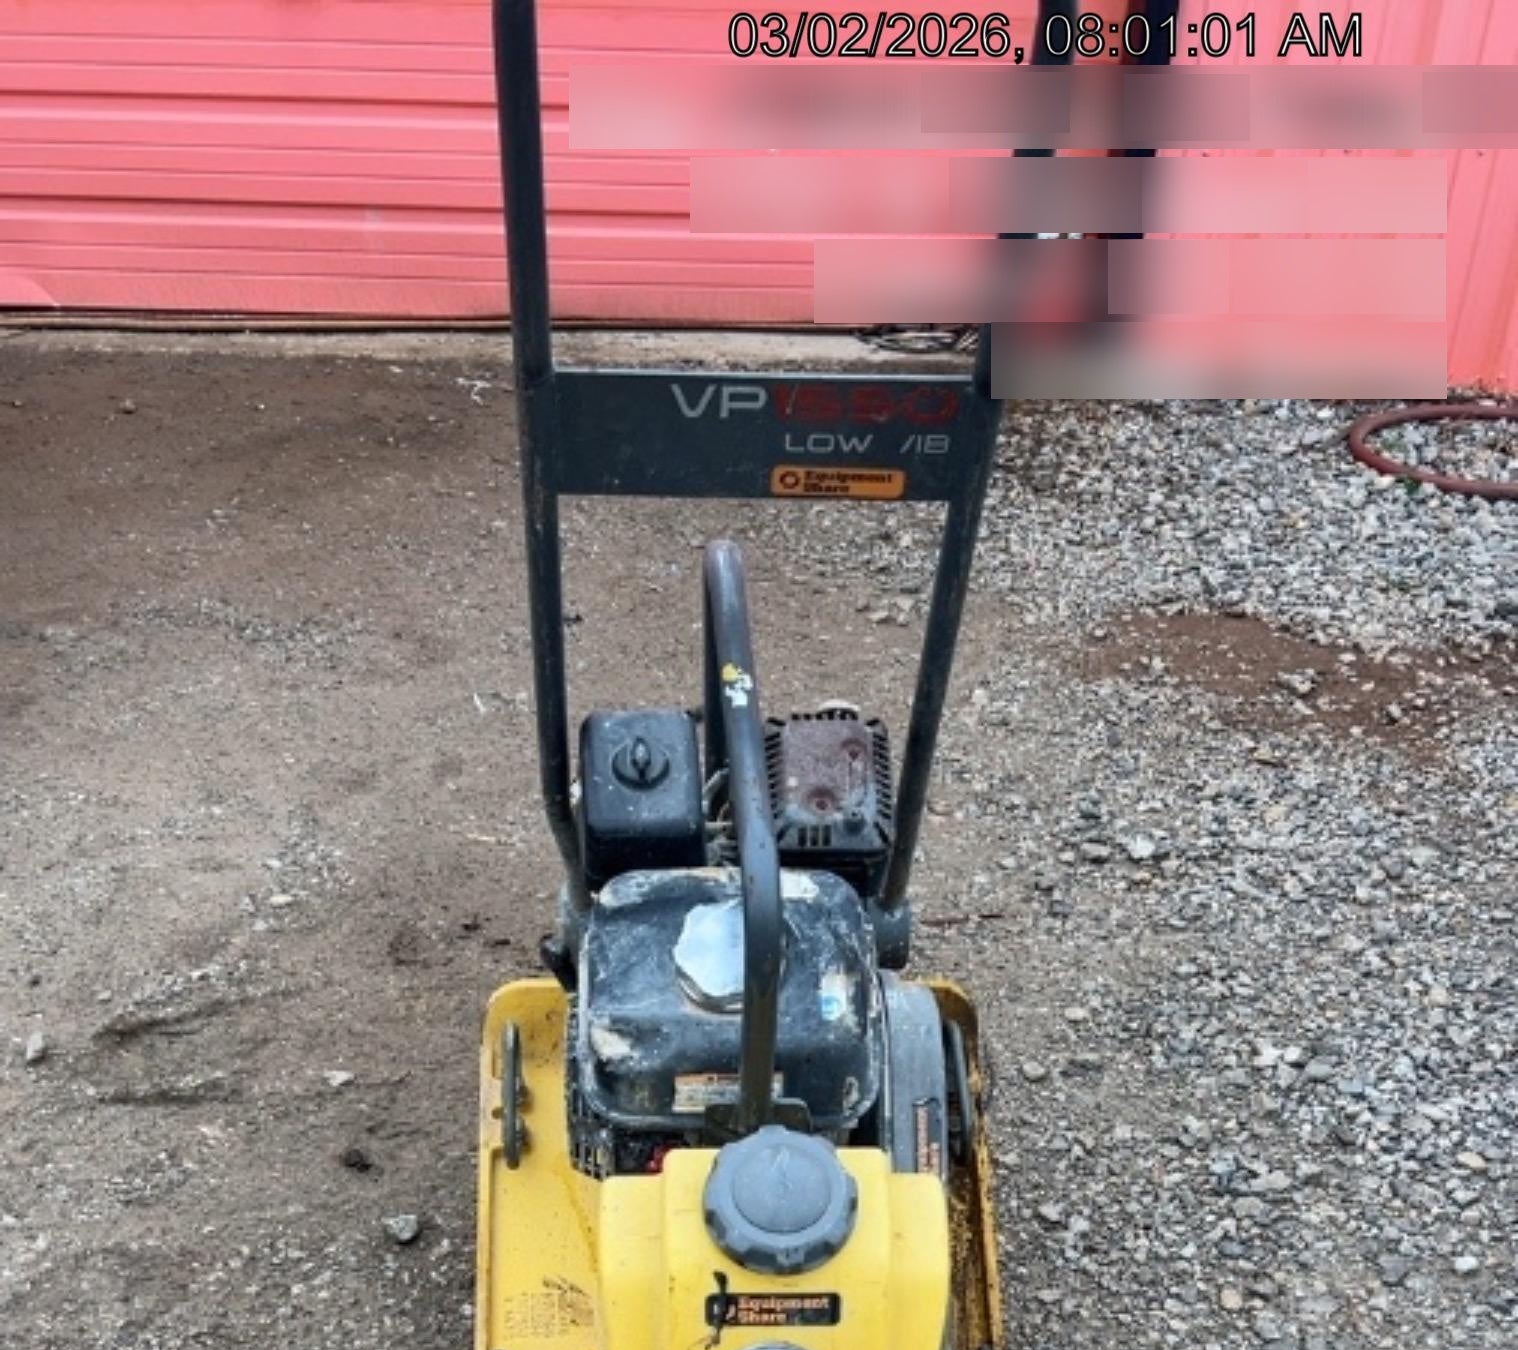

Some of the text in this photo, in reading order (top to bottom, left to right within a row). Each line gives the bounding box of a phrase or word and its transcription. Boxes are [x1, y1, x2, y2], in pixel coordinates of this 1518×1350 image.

[784, 433, 874, 454] LOW
[737, 1295, 829, 1311] Equipment
[737, 1311, 787, 1324] Share
